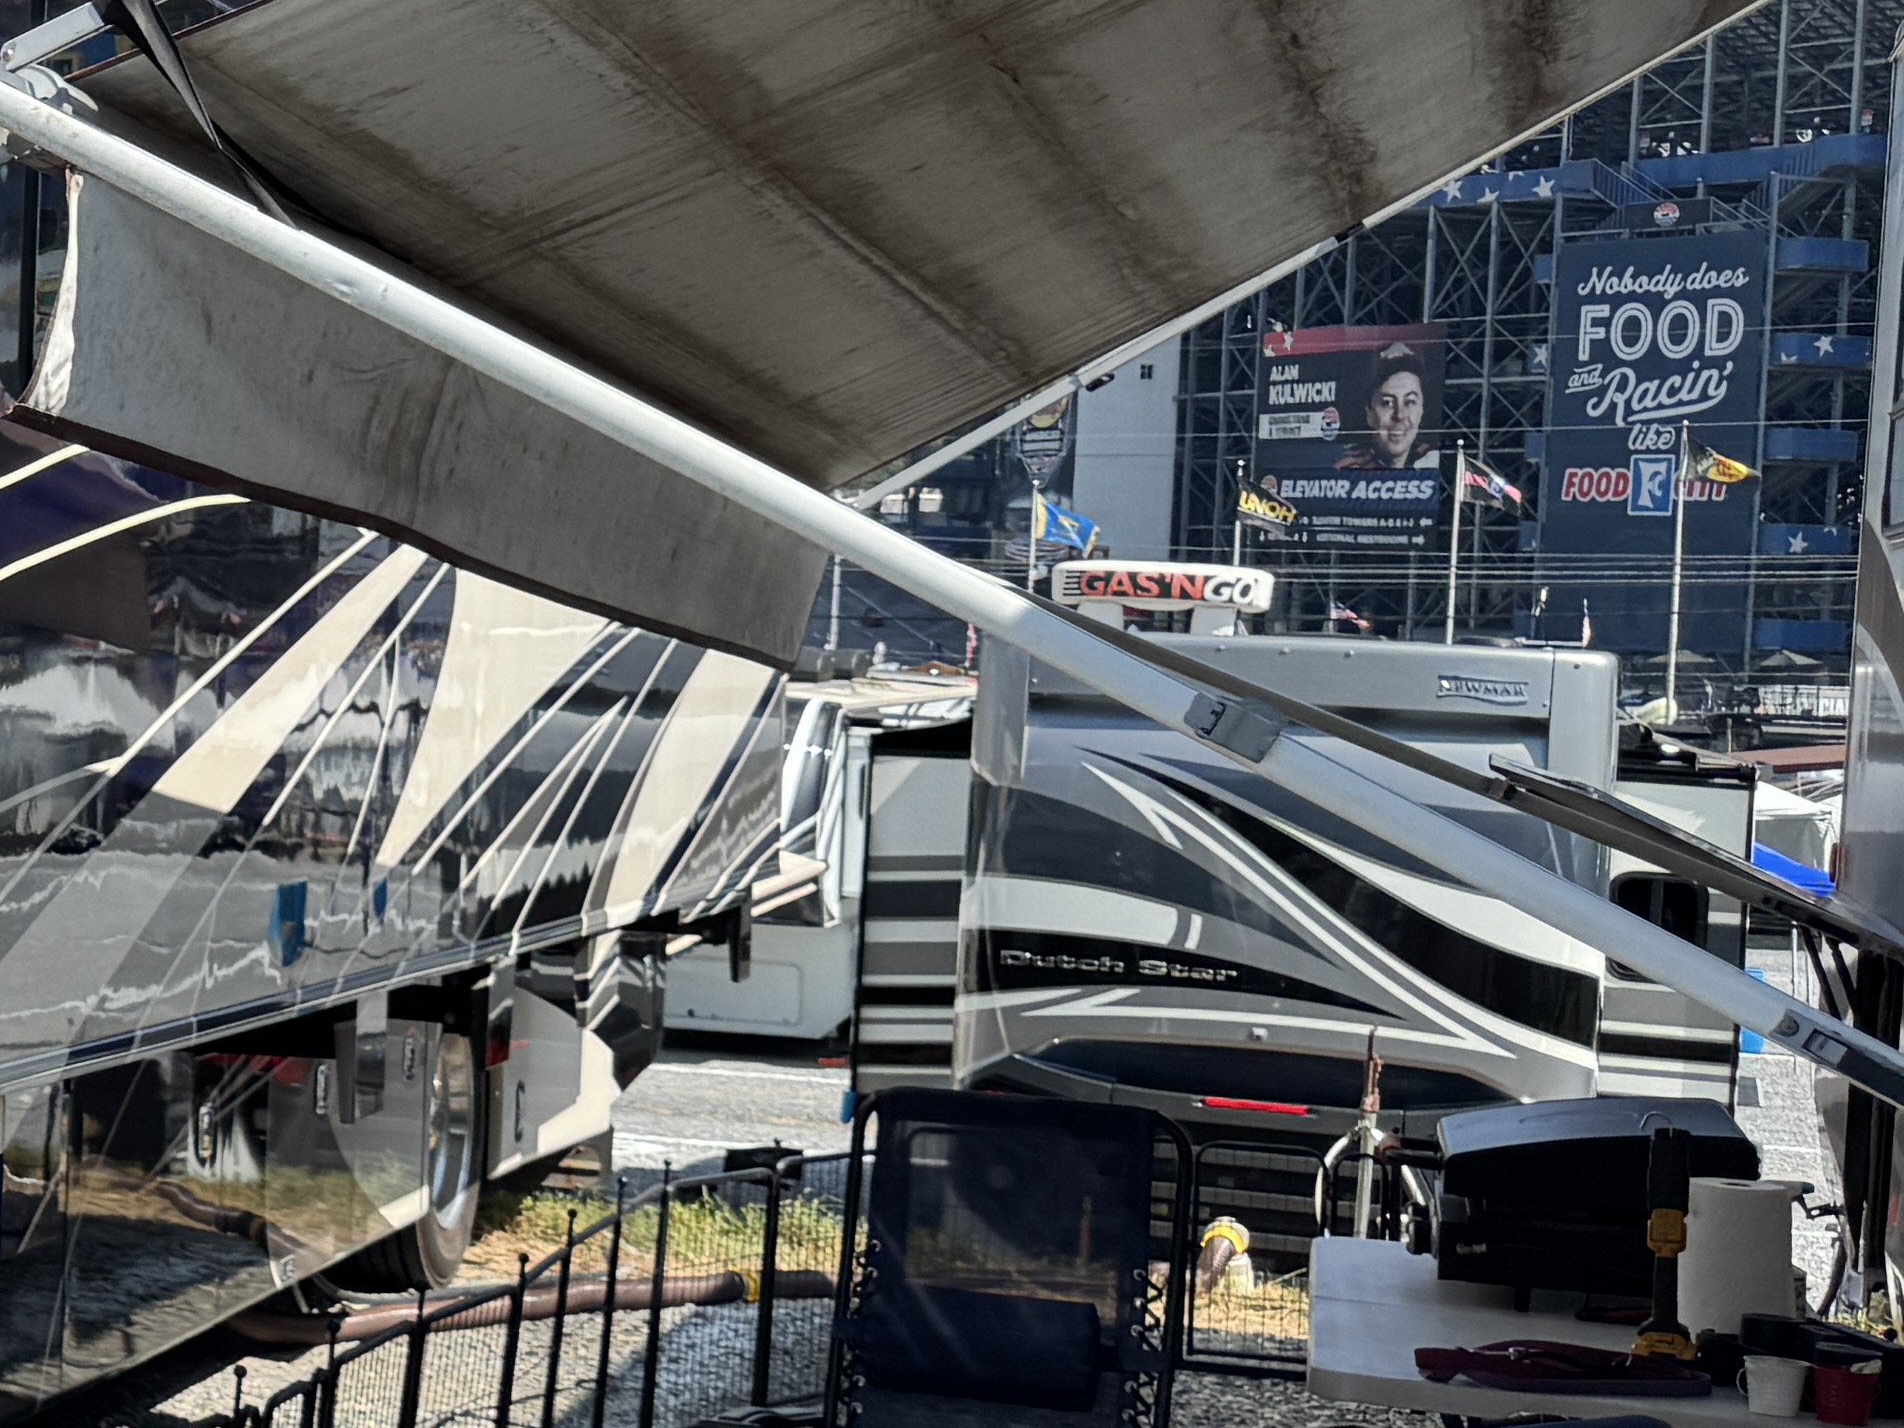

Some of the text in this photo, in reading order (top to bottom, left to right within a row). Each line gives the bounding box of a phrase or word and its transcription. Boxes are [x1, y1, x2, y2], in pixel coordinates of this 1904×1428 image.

[1578, 262, 1749, 299] Nobody does
[1579, 298, 1744, 361] FOOD
[1269, 364, 1299, 382] ALAN
[1269, 381, 1336, 405] KULWICKI
[1565, 360, 1733, 427] and Racin'
[1628, 423, 1675, 450] like
[1280, 479, 1436, 500] ELEVATOR ACCESS
[1562, 468, 1630, 501] FOOD
[1000, 949, 1237, 981] Dutch Star
